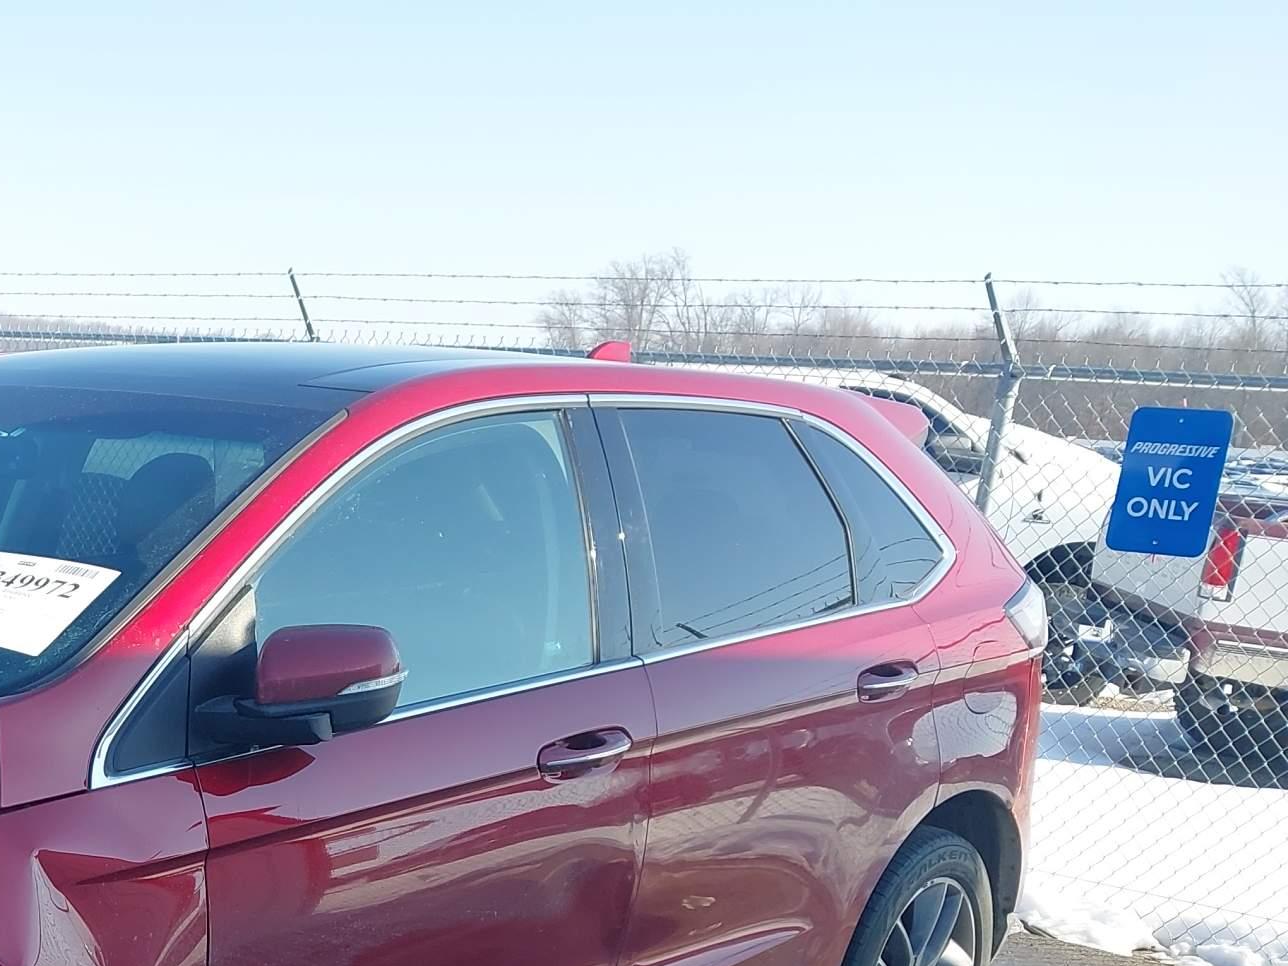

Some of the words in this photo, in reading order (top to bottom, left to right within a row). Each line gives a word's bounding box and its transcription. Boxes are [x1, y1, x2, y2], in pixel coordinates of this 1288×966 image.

[1131, 441, 1220, 458] PROGRESSIVE
[1148, 466, 1193, 489] VIC
[1127, 497, 1199, 521] ONLY
